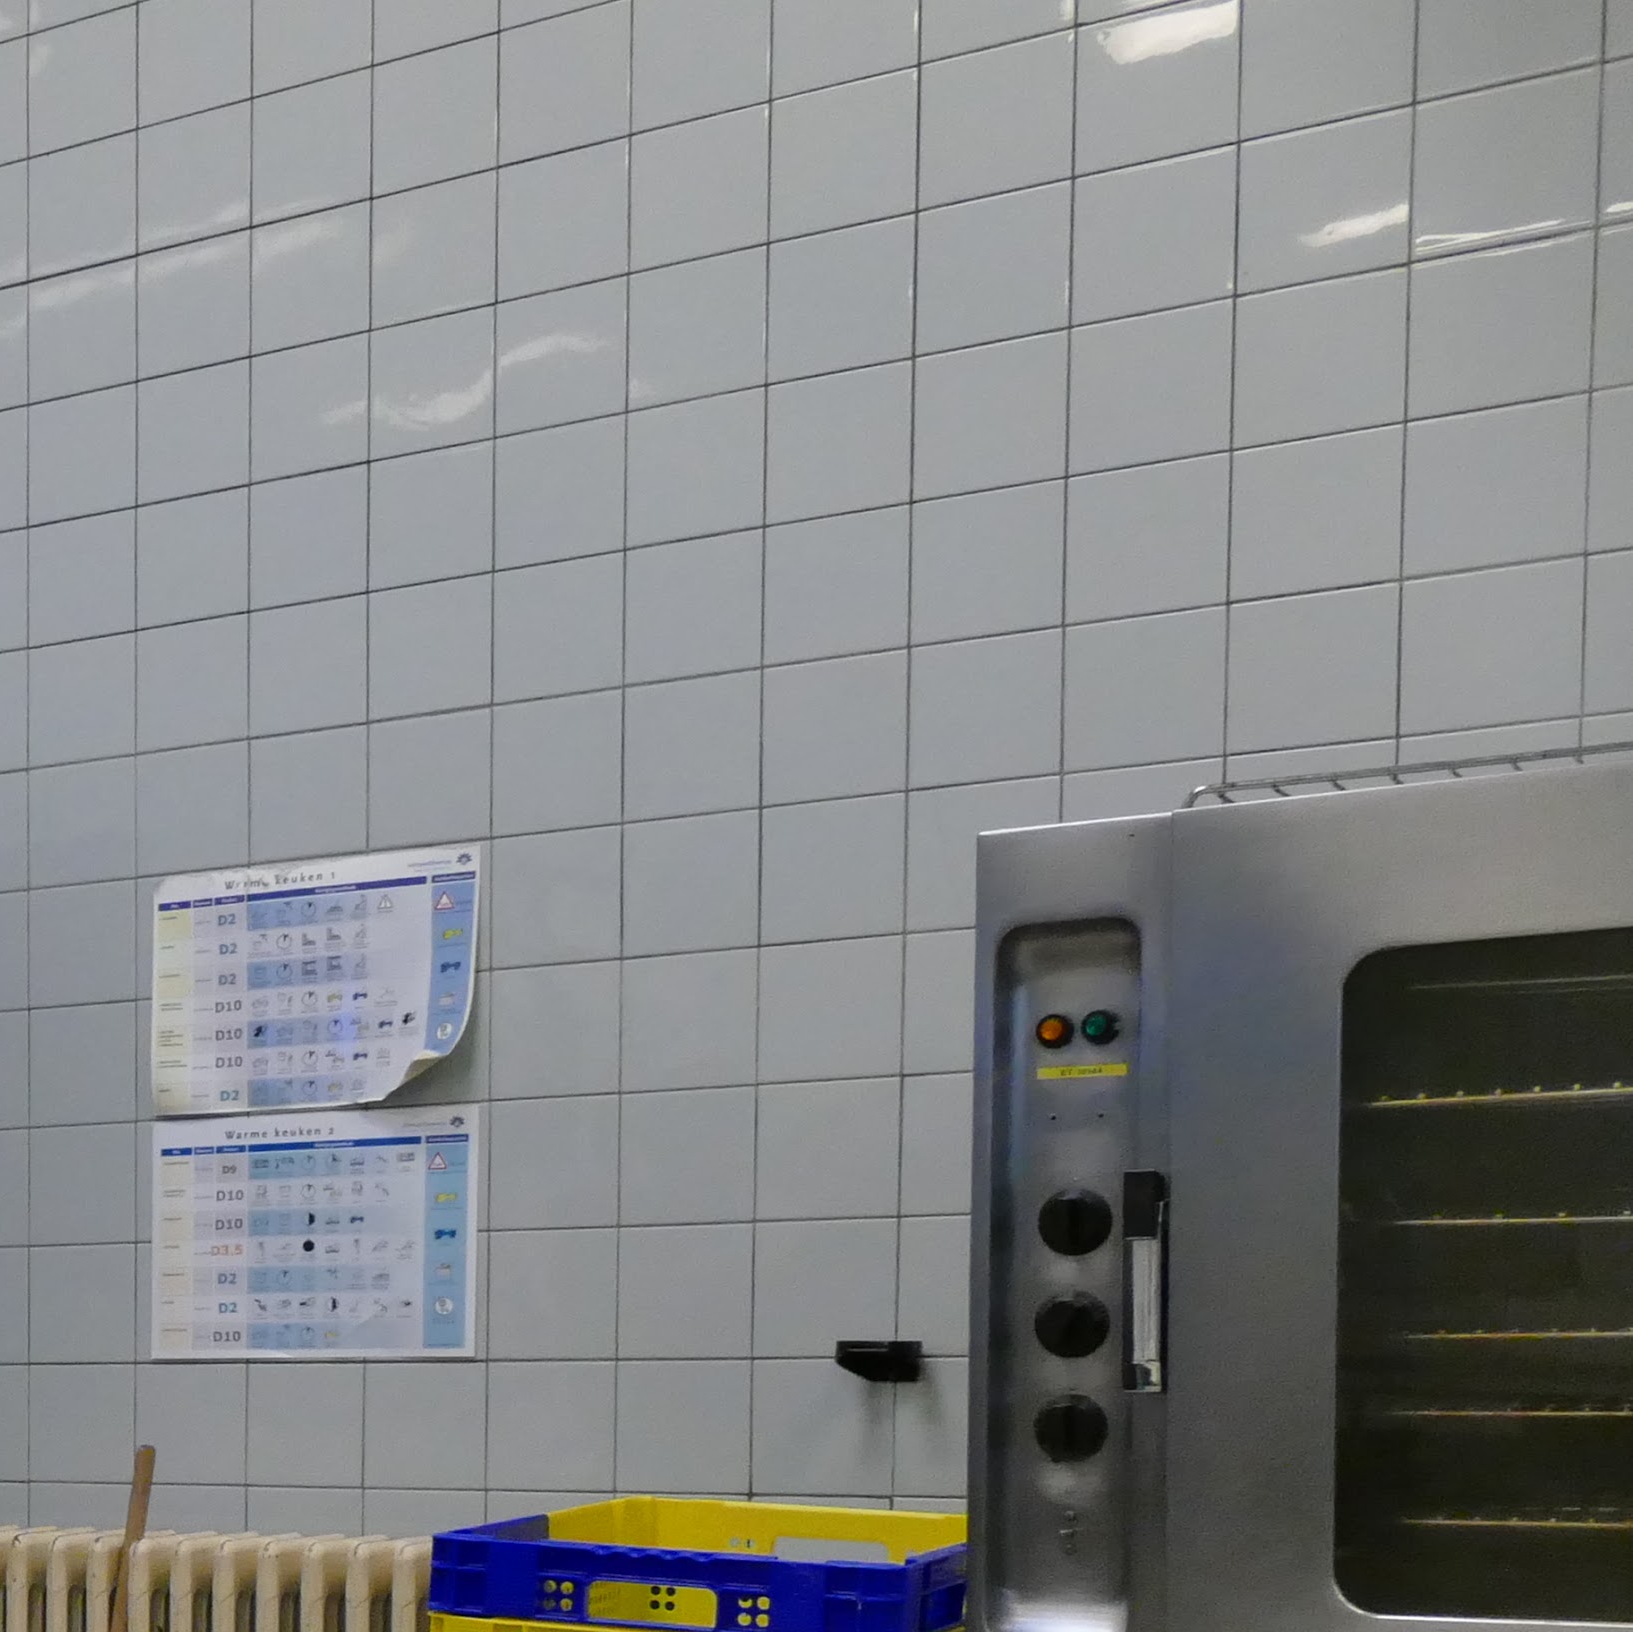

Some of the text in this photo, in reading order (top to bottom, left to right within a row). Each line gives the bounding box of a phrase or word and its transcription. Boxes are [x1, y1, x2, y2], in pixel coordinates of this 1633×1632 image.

[217, 913, 237, 926] D2
[219, 942, 238, 955] D2
[218, 973, 237, 986] D2
[215, 999, 243, 1013] D10
[215, 1028, 243, 1042] D10
[215, 1056, 243, 1069] D10
[220, 1090, 240, 1102] D2
[224, 1128, 269, 1140] Warme
[273, 1125, 322, 1138] keuken
[216, 1189, 244, 1202] D10
[215, 1217, 244, 1231] D10
[217, 1271, 238, 1285] D2
[218, 1302, 238, 1315] D2
[213, 1330, 242, 1343] D10
